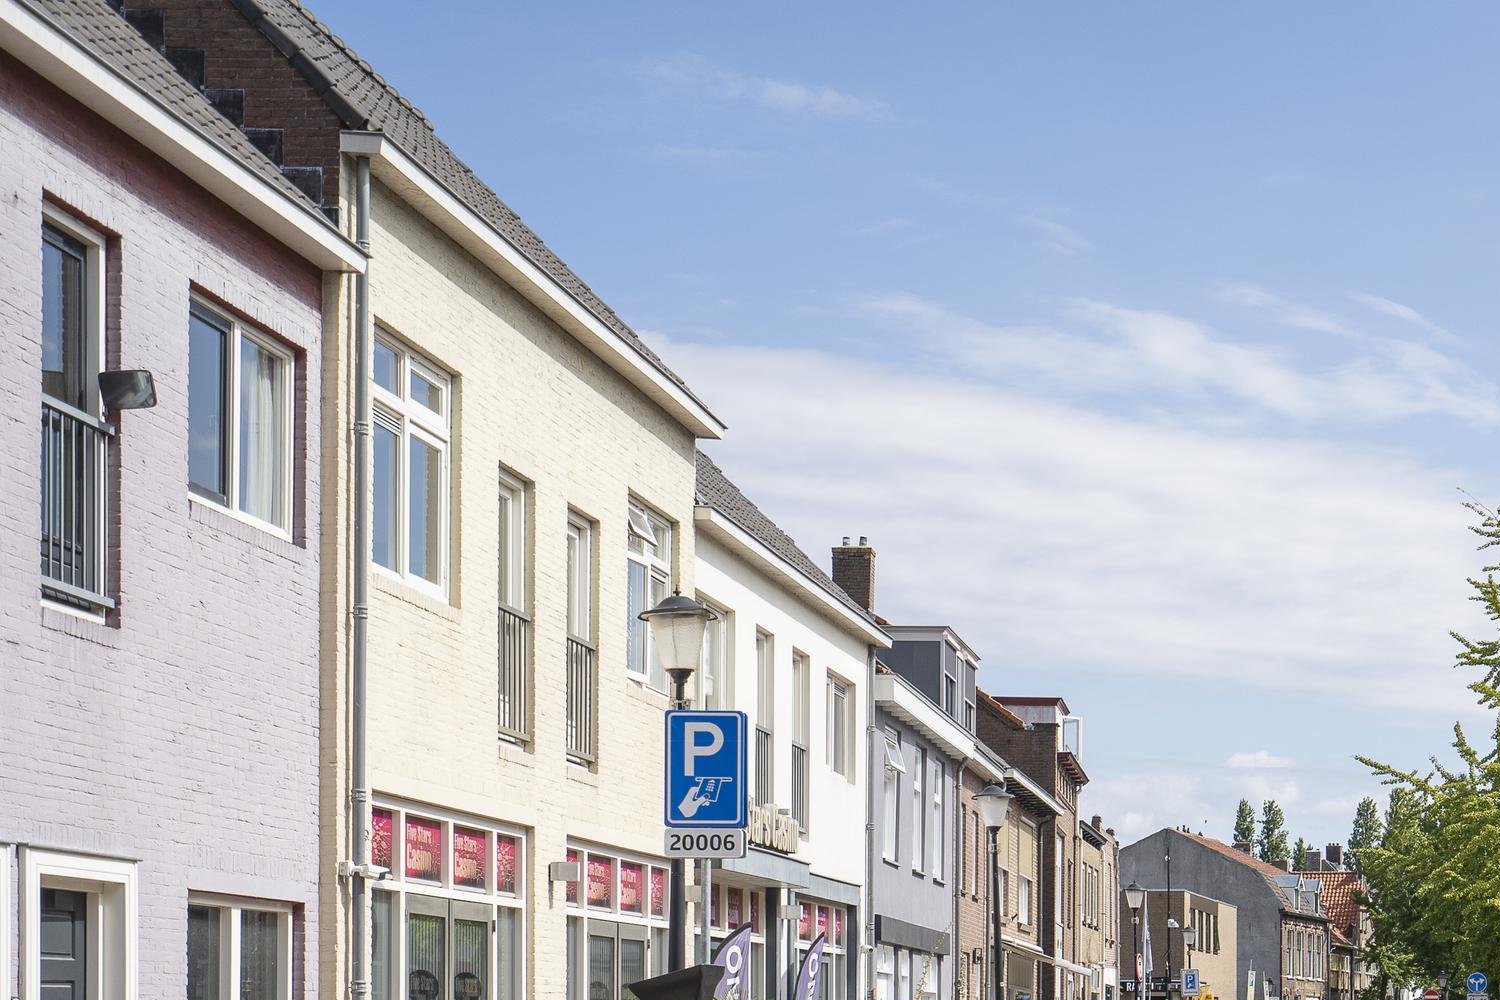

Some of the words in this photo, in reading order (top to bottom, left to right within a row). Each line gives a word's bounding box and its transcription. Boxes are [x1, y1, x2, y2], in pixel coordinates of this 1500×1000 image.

[684, 722, 724, 777] P
[407, 823, 417, 842] Five
[418, 826, 432, 844] Stars
[670, 834, 735, 851] 20006
[407, 844, 432, 872] Casino
[1187, 975, 1194, 984] P
